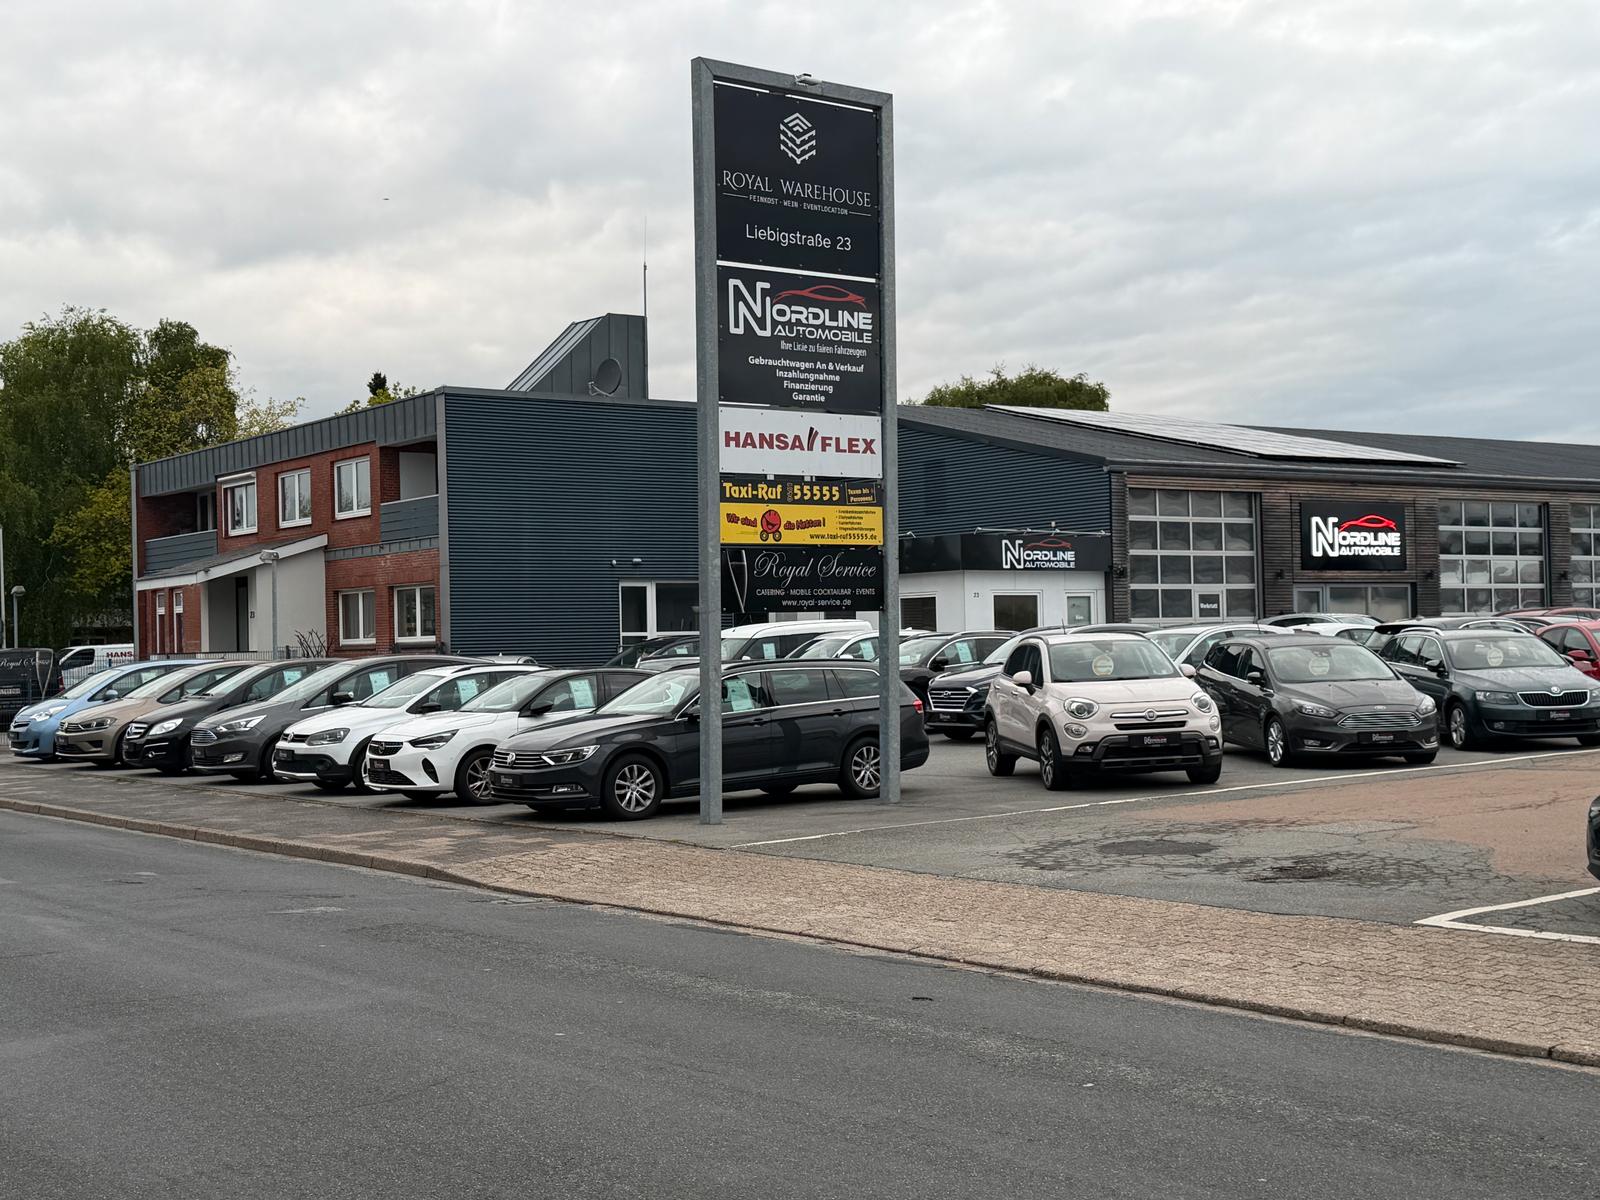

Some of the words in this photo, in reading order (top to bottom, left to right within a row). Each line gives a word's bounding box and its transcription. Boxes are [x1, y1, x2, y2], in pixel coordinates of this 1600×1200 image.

[723, 170, 773, 192] ROYAL
[780, 179, 871, 208] WAREHOUSE
[750, 194, 778, 205] FEINKOST
[783, 200, 798, 208] WEIN
[803, 203, 848, 215] EVENTLOCATION
[746, 223, 831, 248] Liebigstraße
[836, 236, 851, 251] 23
[728, 278, 873, 337] NORDLINE
[773, 325, 873, 344] AUTOMOBILE
[781, 340, 792, 351] Ihre
[793, 342, 807, 352] Linie
[817, 343, 833, 354] fairen
[834, 345, 867, 358] Fahrzeugen
[748, 355, 815, 370] Gebrauchtwagen
[816, 361, 827, 370] An
[828, 362, 834, 370] &
[835, 363, 864, 373] Verkauf
[776, 369, 840, 382] Inzahlungnahme
[783, 381, 833, 393] Finanzierung
[792, 392, 825, 402] Garantie
[722, 482, 782, 500] Taxi-Ruf
[793, 484, 840, 501] 55555
[1310, 516, 1401, 557] NORDLINE
[1001, 539, 1076, 569] NORDLINE
[1339, 546, 1401, 556] AUTOMOBILE
[753, 551, 814, 588] Royal
[817, 551, 877, 582] Service
[756, 588, 785, 596] CATERING
[790, 588, 812, 596] MOBILE
[813, 588, 851, 596] COCKTAILBAR
[781, 599, 852, 607] www.royal-service.de
